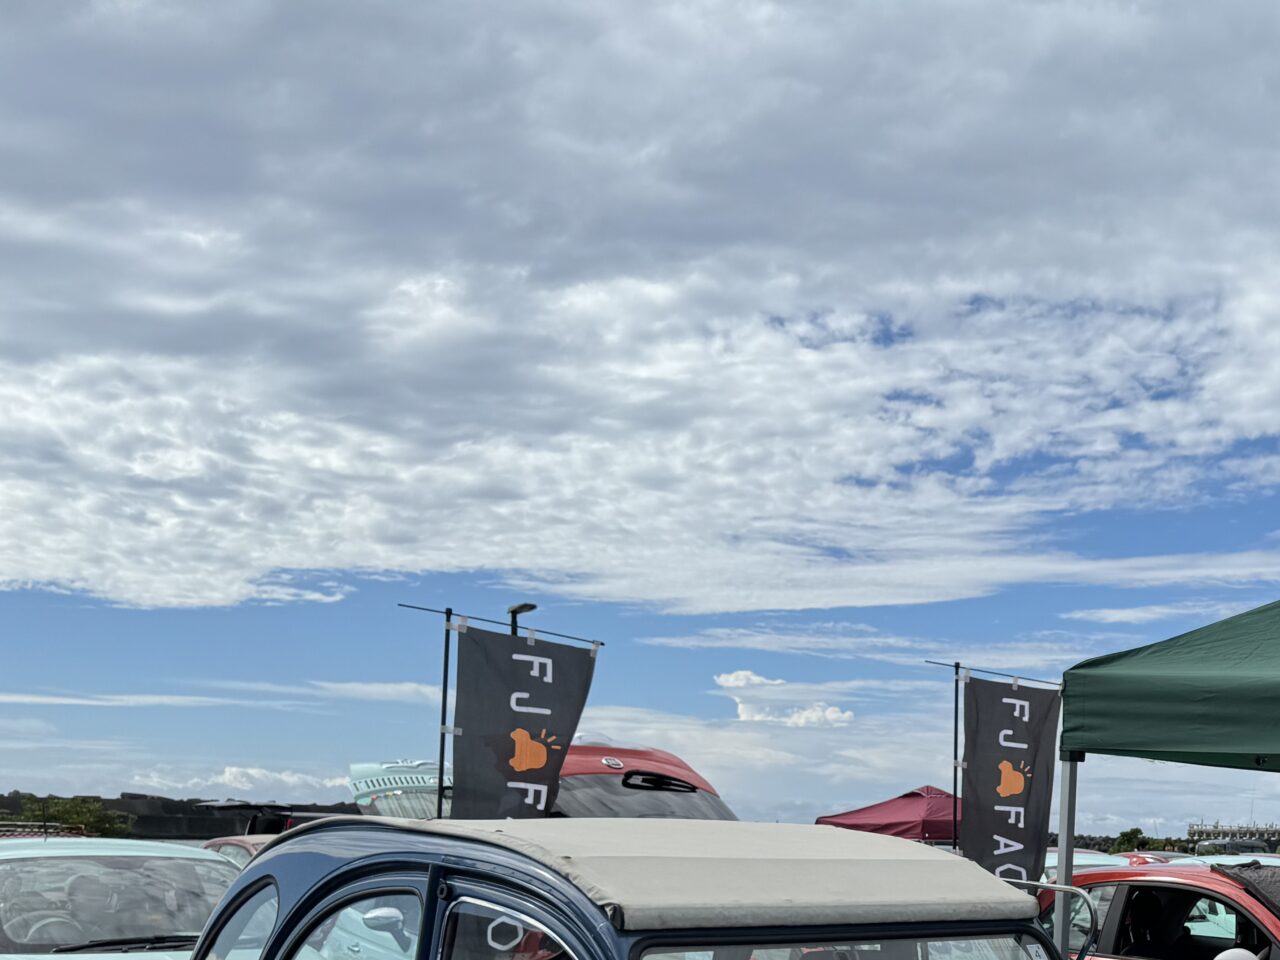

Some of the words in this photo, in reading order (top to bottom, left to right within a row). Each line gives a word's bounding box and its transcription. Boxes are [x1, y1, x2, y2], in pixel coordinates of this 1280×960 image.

[509, 652, 554, 716] FJ
[998, 697, 1030, 751] FJ
[506, 781, 548, 811] F
[993, 804, 1029, 890] FAC
